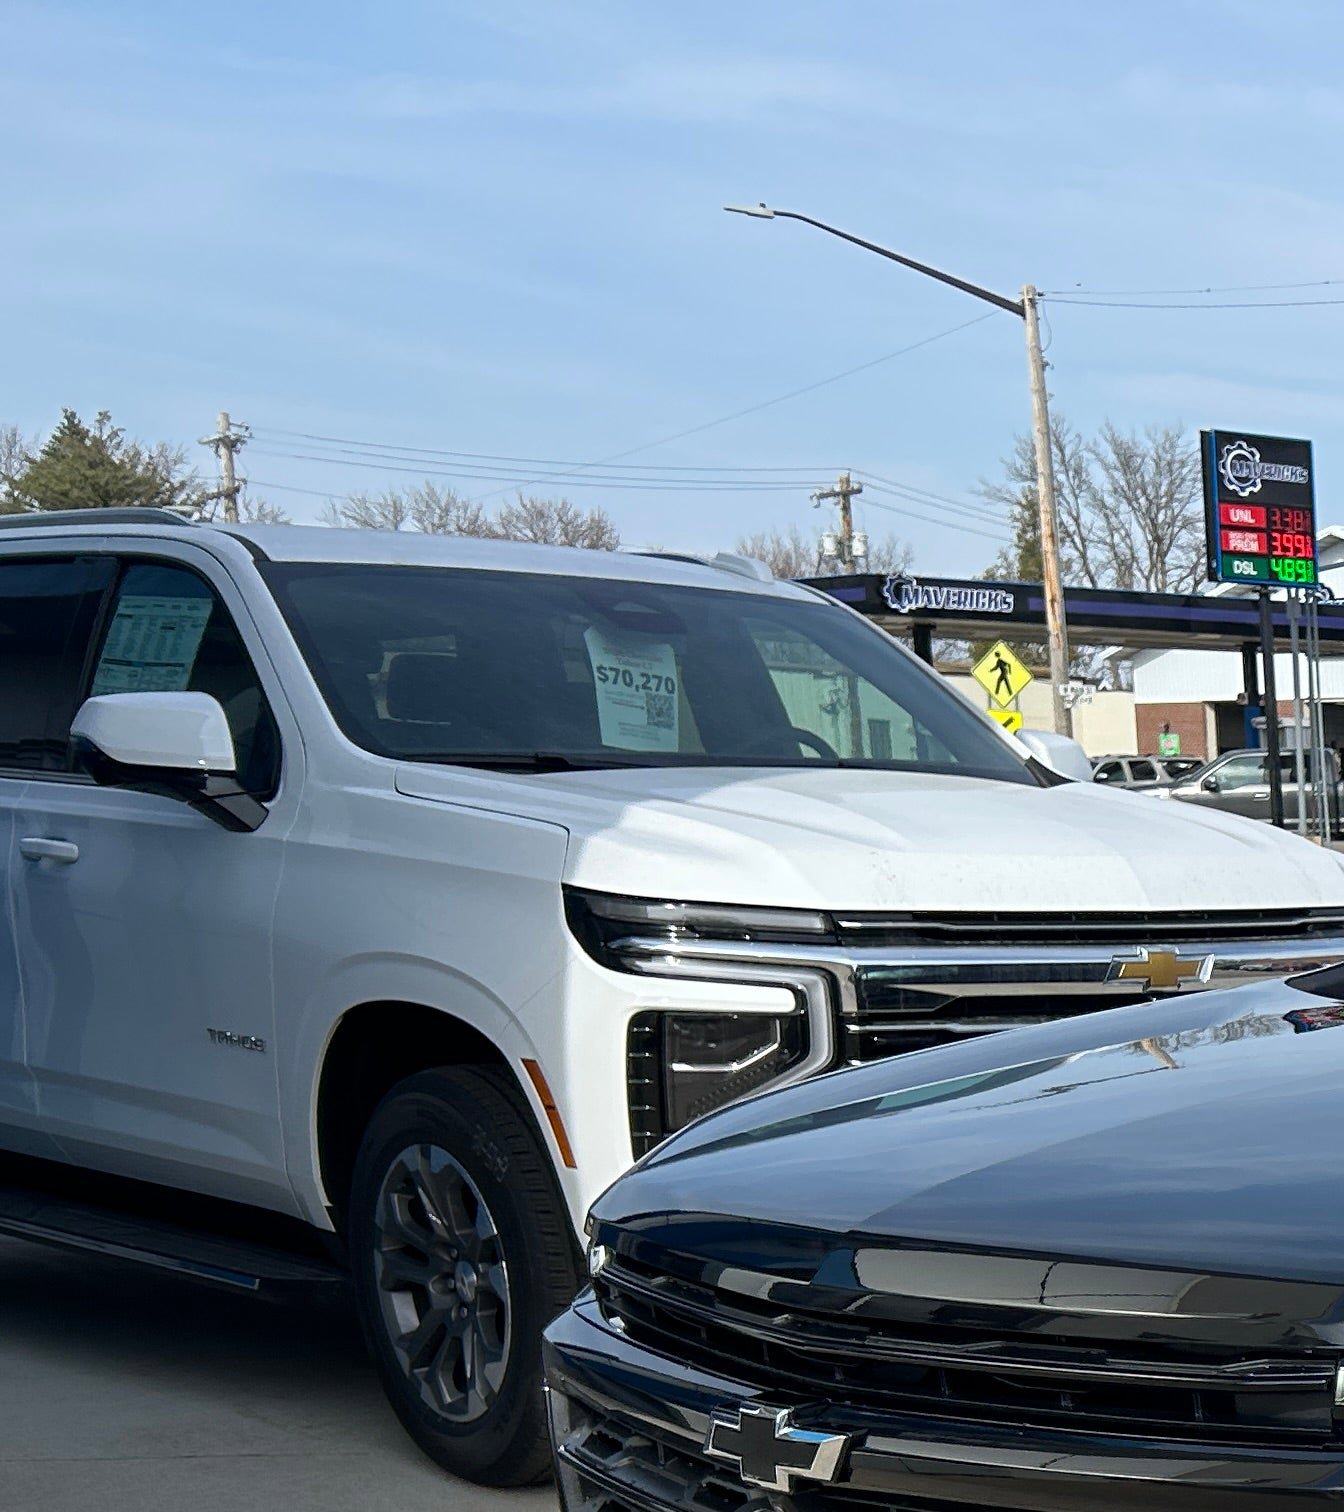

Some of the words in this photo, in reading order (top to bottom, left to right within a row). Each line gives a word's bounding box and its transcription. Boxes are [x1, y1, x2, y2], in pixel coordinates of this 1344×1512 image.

[1229, 508, 1256, 524] UNL
[1232, 559, 1258, 576] DSL
[595, 664, 676, 695] $70,270
